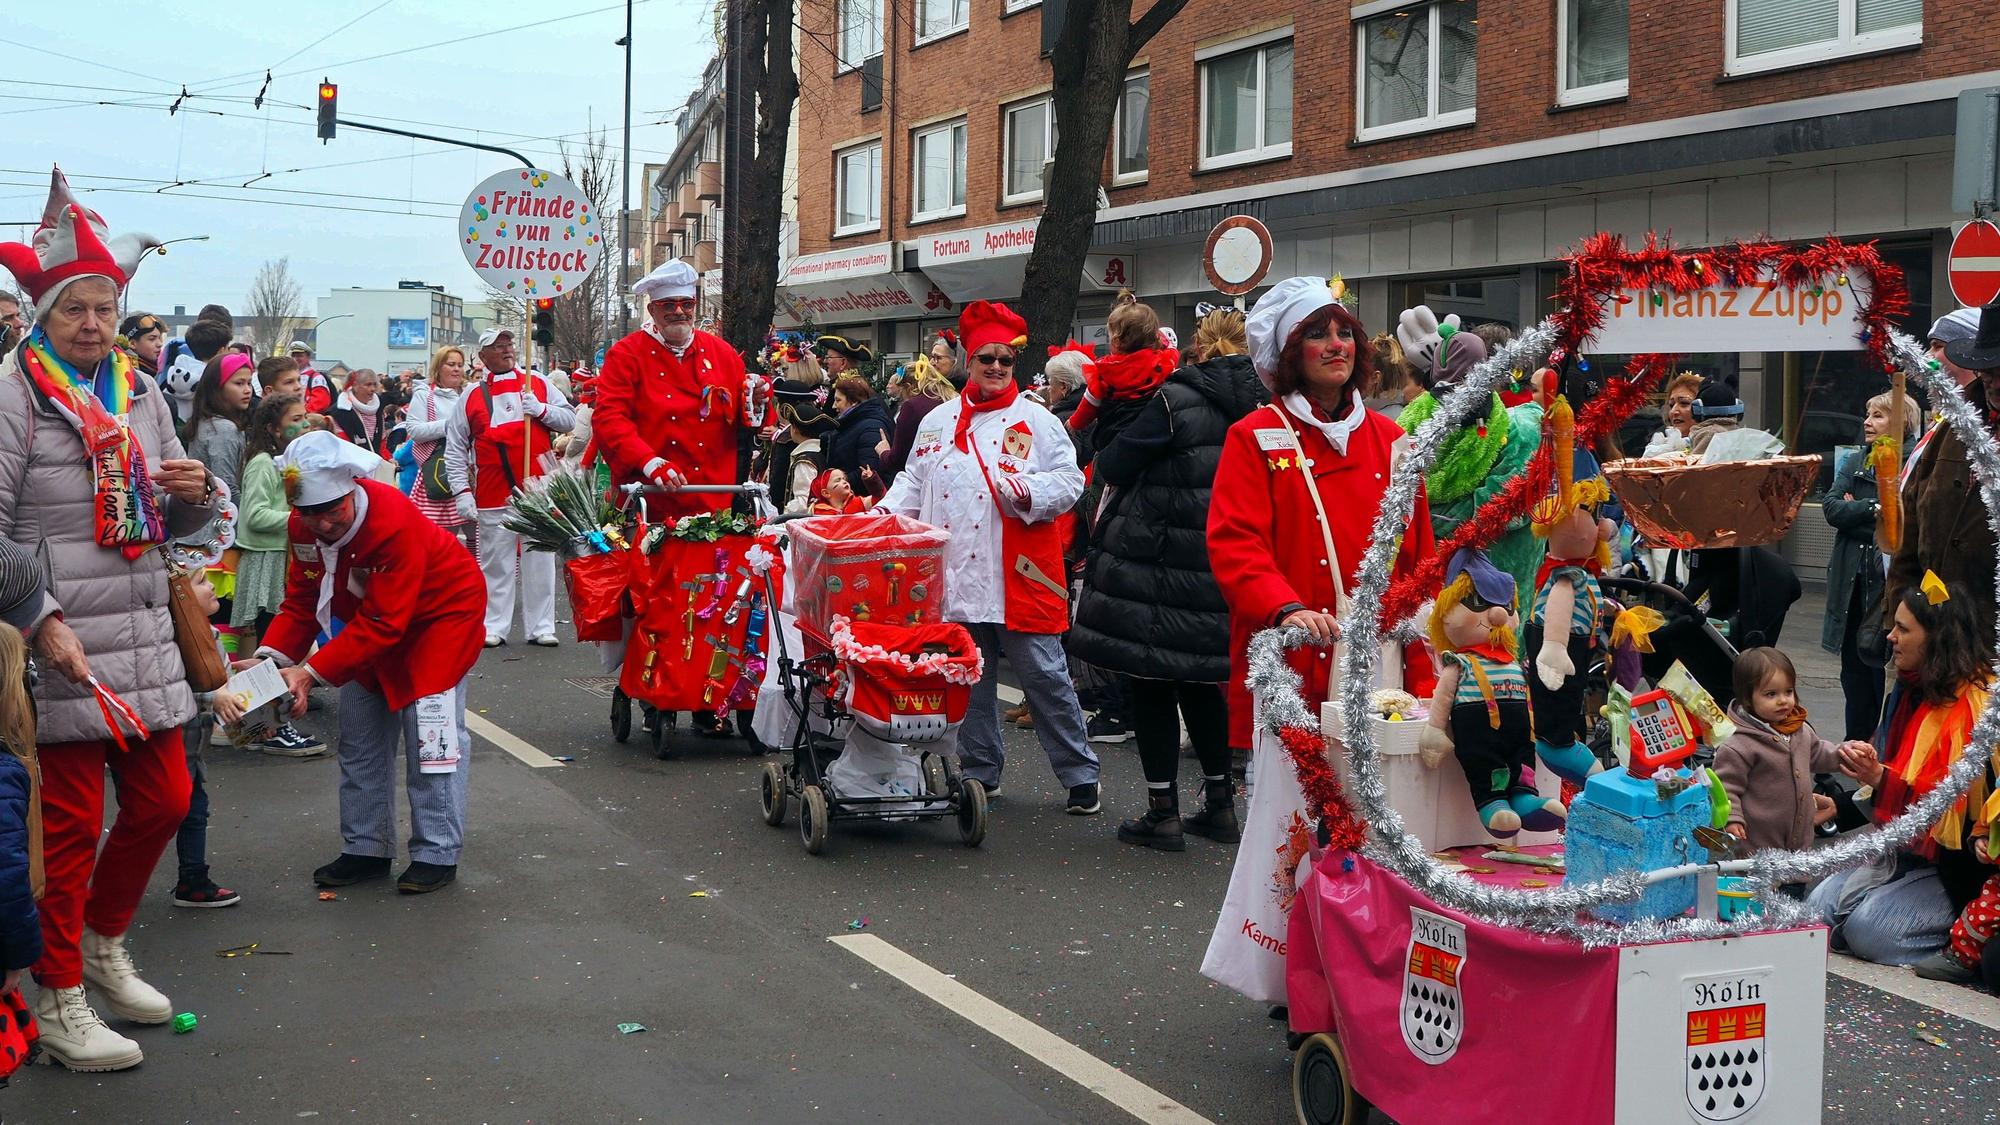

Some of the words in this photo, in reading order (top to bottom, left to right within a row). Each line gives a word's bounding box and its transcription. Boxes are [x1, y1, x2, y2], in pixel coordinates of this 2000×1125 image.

[491, 190, 575, 219] Fründe
[515, 224, 550, 241] vun
[933, 239, 970, 257] Fortuna
[984, 227, 1035, 254] Apotheke
[475, 243, 588, 272] Zollstock
[824, 259, 852, 274] pharmacy
[852, 252, 888, 267] consultancy
[799, 294, 854, 313] Fortuna
[845, 285, 913, 312] Apotheke
[1748, 281, 1843, 326] Zupp
[103, 494, 118, 521] 200
[122, 488, 136, 521] Alaaf
[1418, 917, 1458, 950] Köln
[1694, 978, 1761, 1006] Köln
